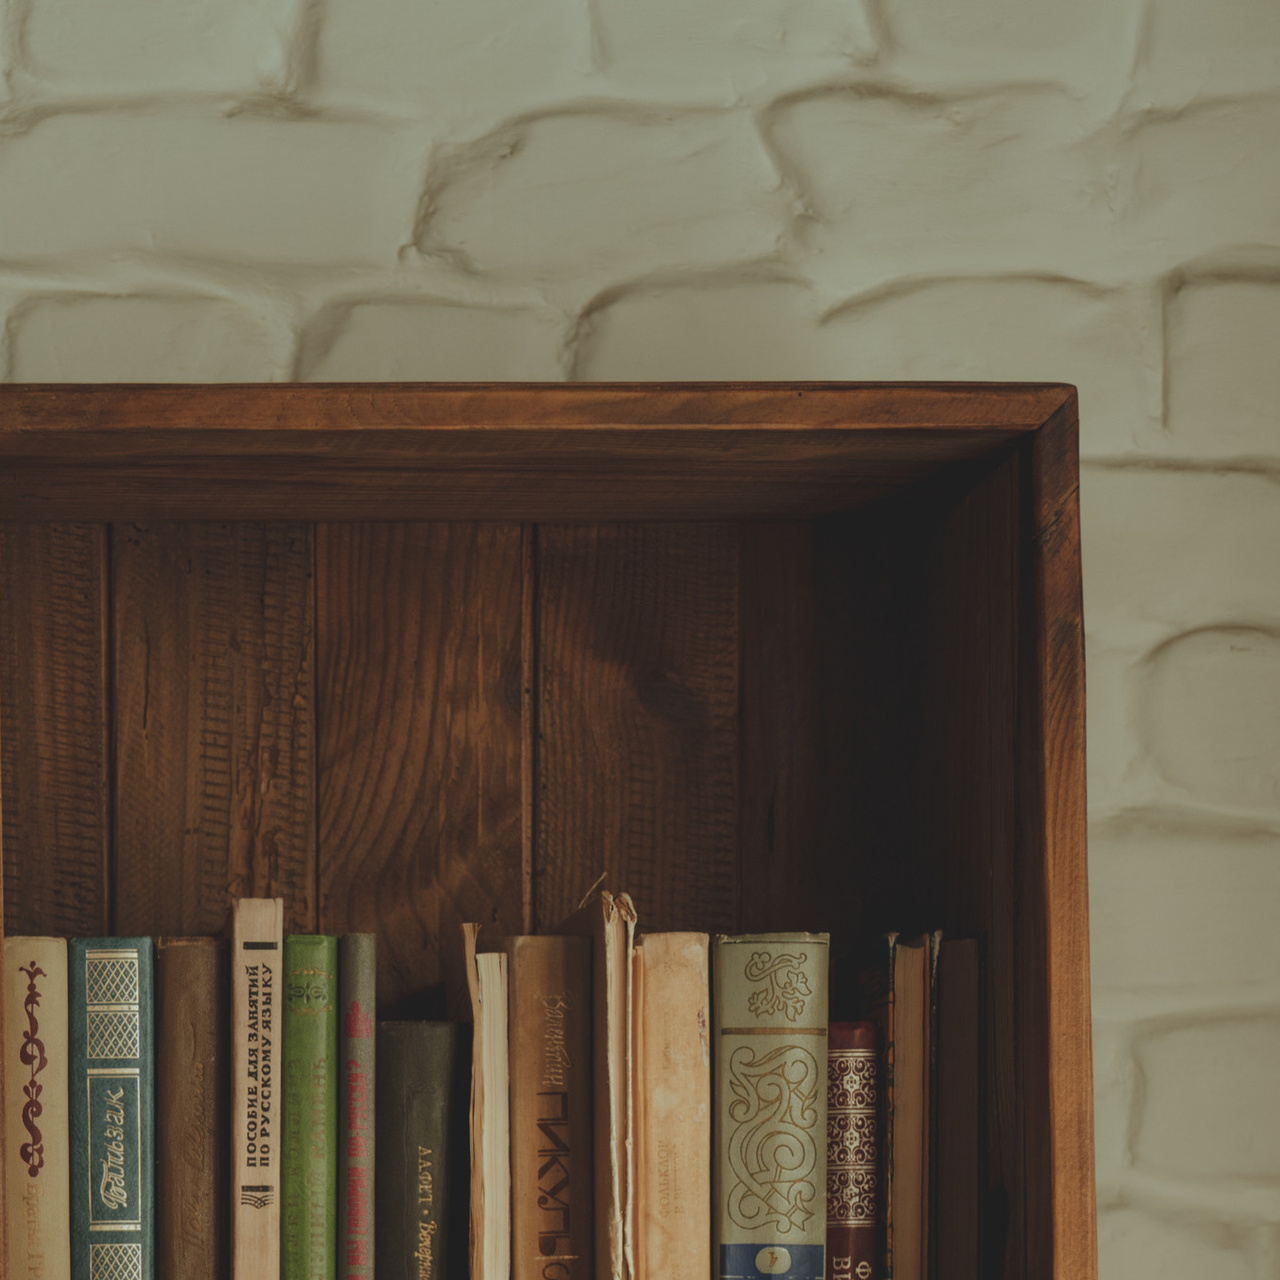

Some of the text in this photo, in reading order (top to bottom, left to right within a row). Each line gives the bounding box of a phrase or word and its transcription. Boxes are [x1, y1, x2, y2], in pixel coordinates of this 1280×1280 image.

[246, 963, 259, 1168] ПОСОБИЕ ДЛЯ ЗАНЯТИЙ
[259, 963, 273, 1167] ПО РУССКОМУ ЯЗЫКУ
[100, 1086, 129, 1211] Бальзак
[347, 1166, 368, 1235] ГОВОРИМ
[536, 1091, 571, 1256] ПИКУЛЬ
[347, 1239, 368, 1266] МЫ
